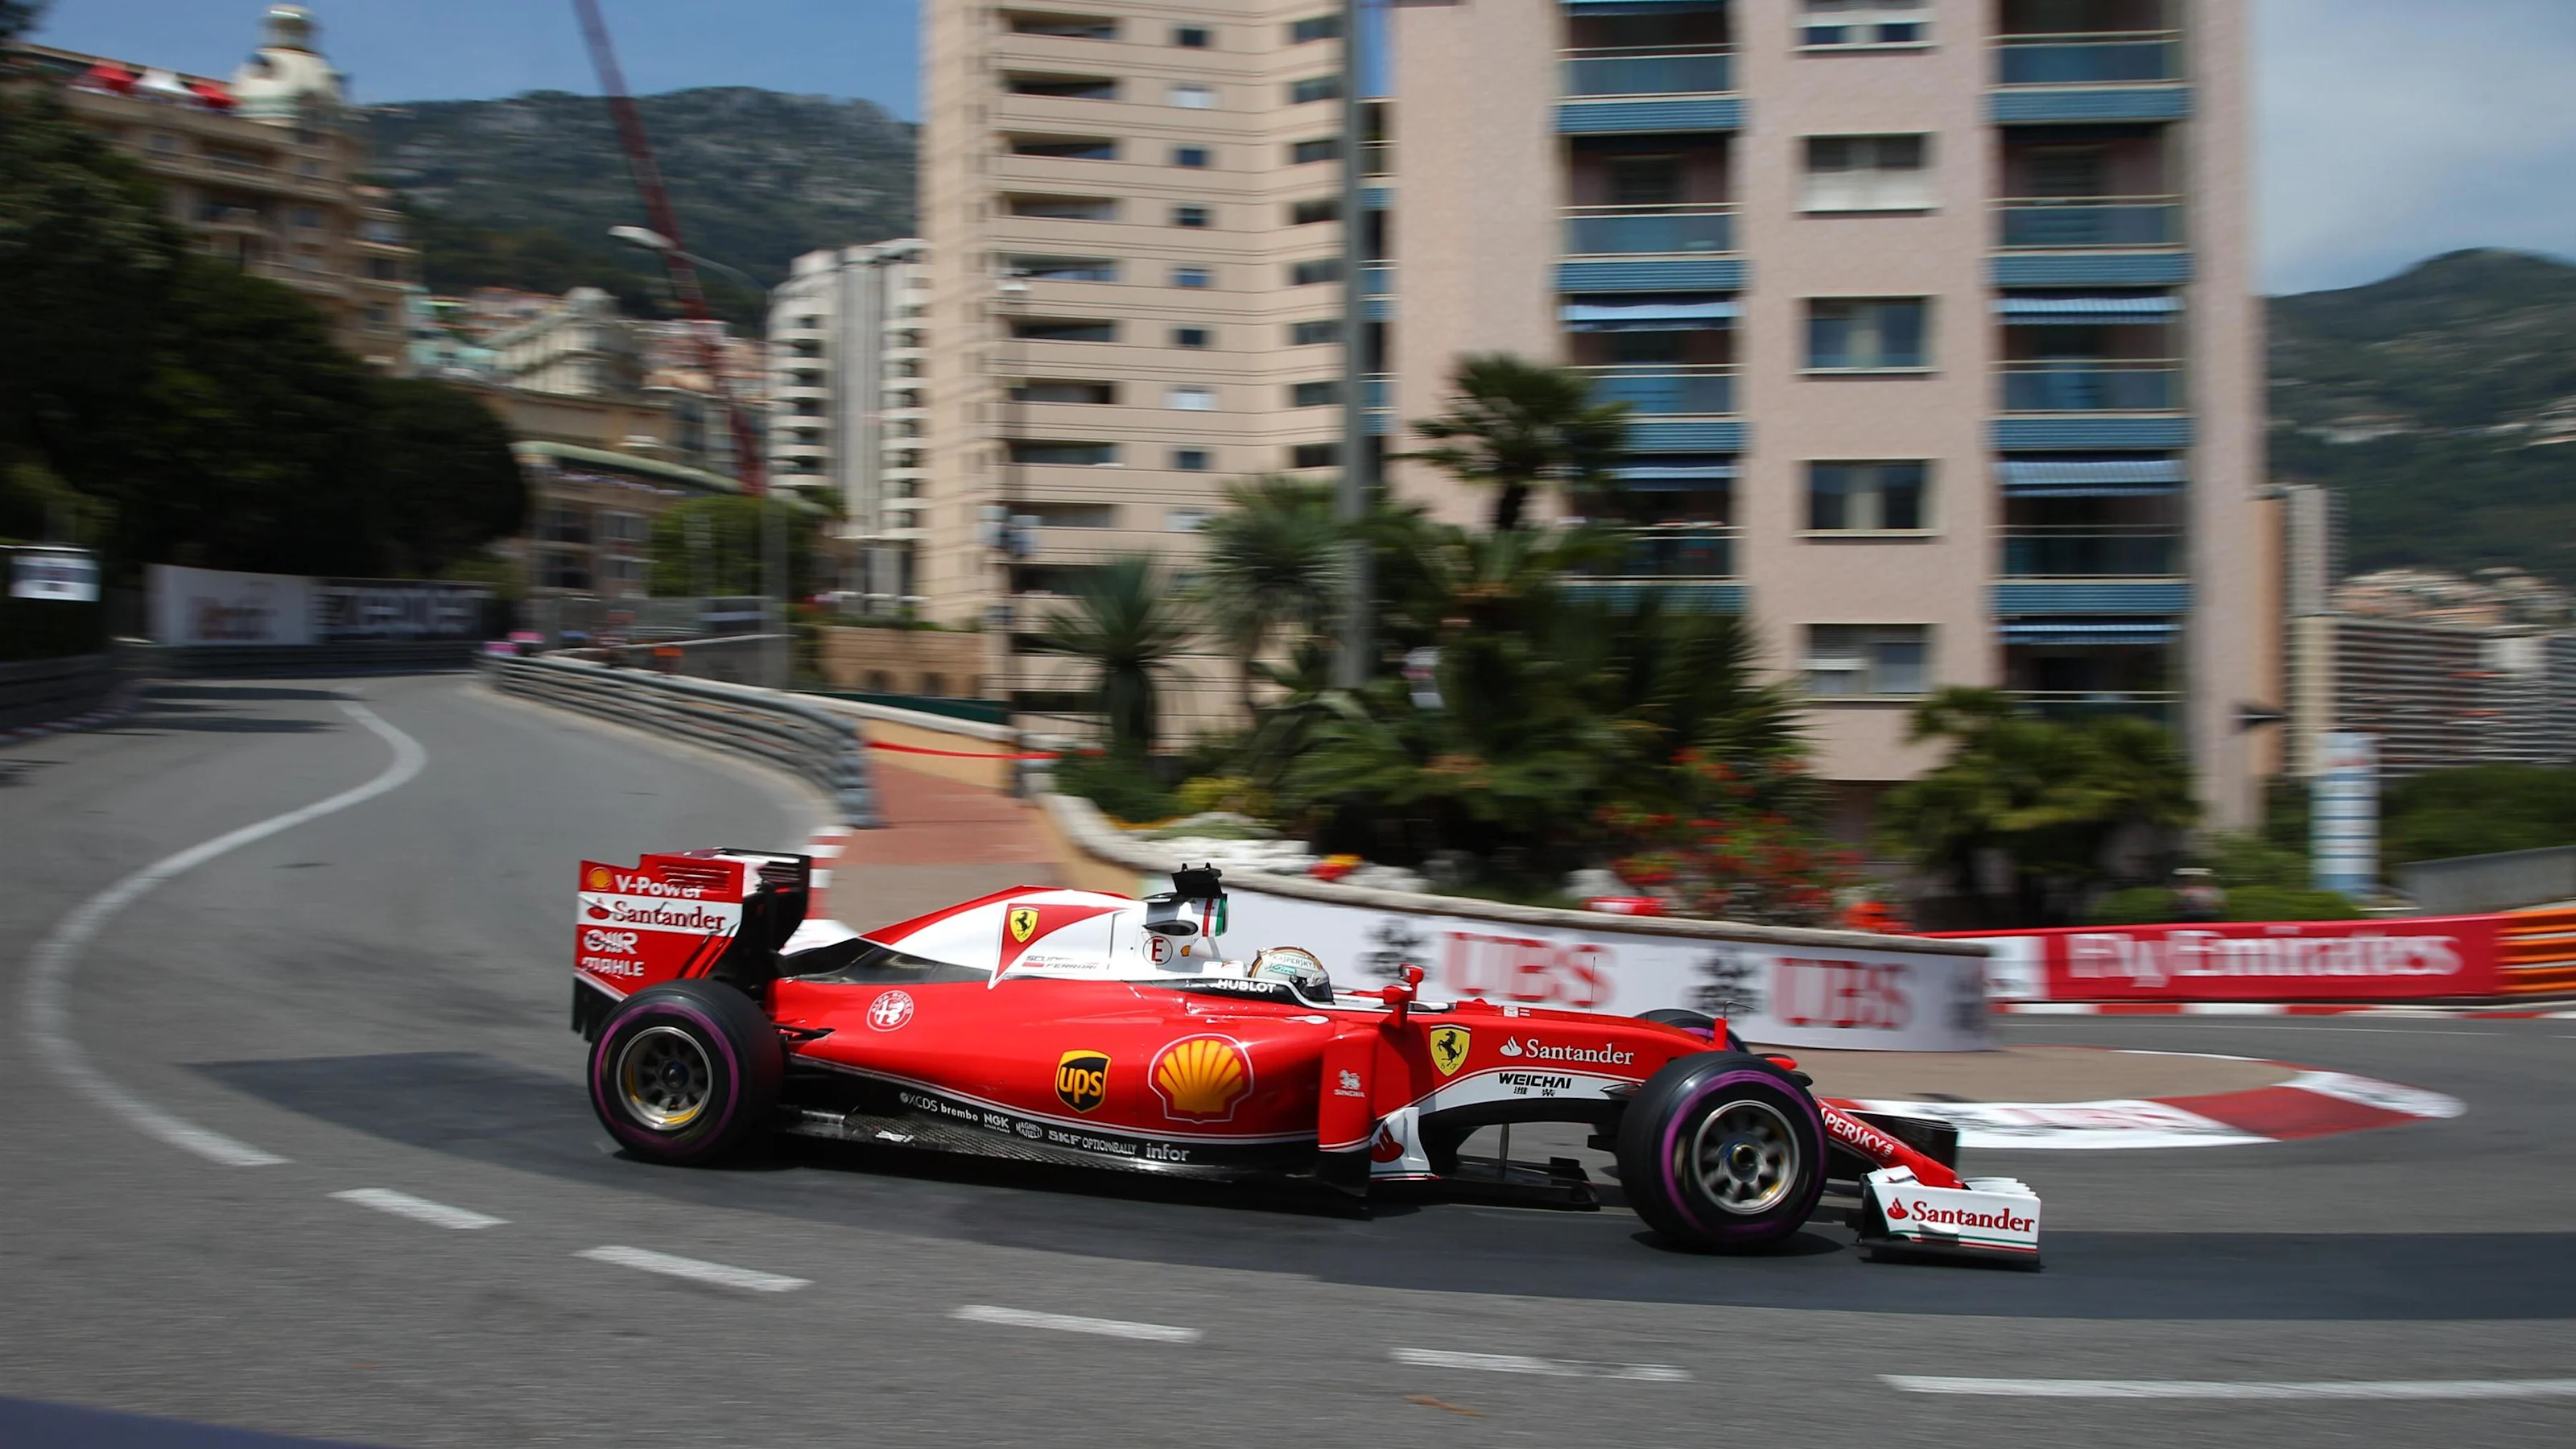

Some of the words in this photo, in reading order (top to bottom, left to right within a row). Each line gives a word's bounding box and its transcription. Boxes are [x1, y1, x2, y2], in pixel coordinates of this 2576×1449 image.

[615, 874, 705, 898] V-Power
[613, 901, 726, 931] Santander
[581, 956, 645, 976] MAHLE
[1272, 956, 1312, 968] KASPERSKY
[2066, 932, 2169, 988] Fly
[2168, 925, 2462, 976] Emirates
[1443, 931, 1613, 1007] UBS
[1216, 978, 1277, 994] HUBLOT
[1769, 956, 1916, 1031] UBS
[1525, 1038, 1635, 1065] Santander
[1059, 1067, 1103, 1104] ups
[1499, 1072, 1572, 1089] WEICHAI
[940, 1103, 979, 1122] brembo
[983, 1113, 1009, 1129] NGK
[1048, 1130, 1082, 1146] SKF
[1146, 1142, 1191, 1162] infor
[1911, 1200, 2036, 1233] Santander
